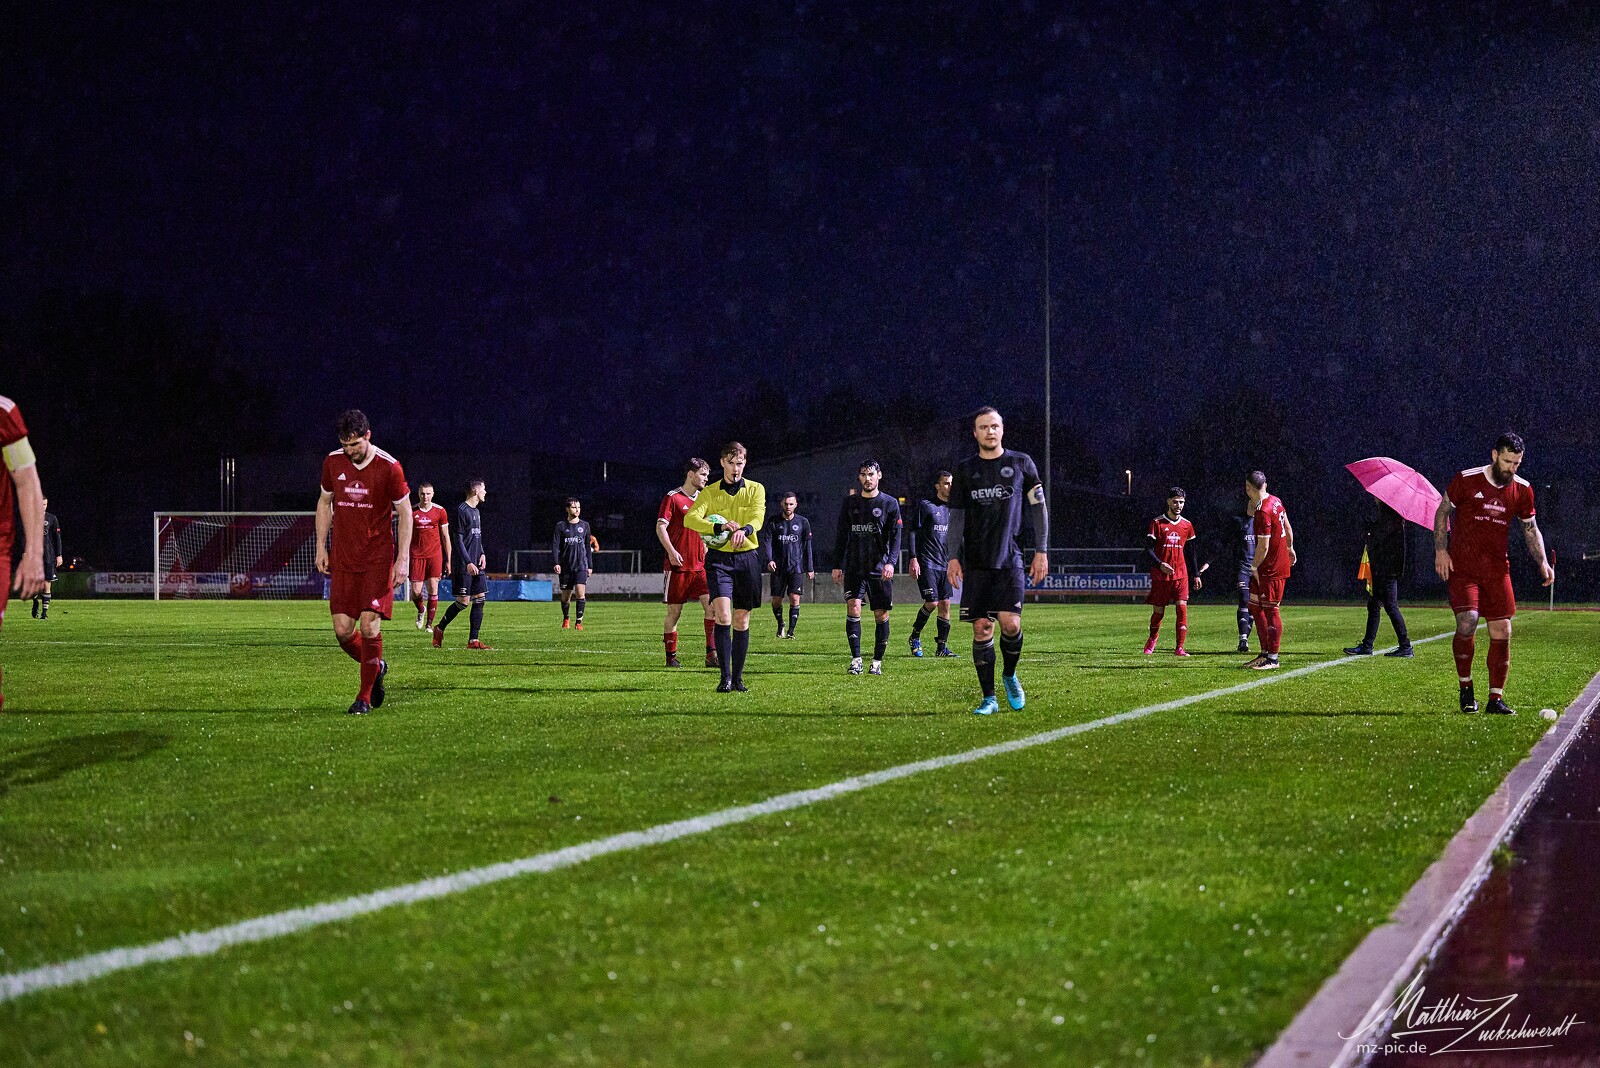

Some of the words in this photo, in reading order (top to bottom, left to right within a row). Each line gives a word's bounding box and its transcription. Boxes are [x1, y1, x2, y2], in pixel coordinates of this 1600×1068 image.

[970, 488, 1003, 500] REWE
[851, 524, 875, 532] REWE
[933, 524, 949, 532] REW
[1043, 575, 1153, 589] Raiffeisenbank
